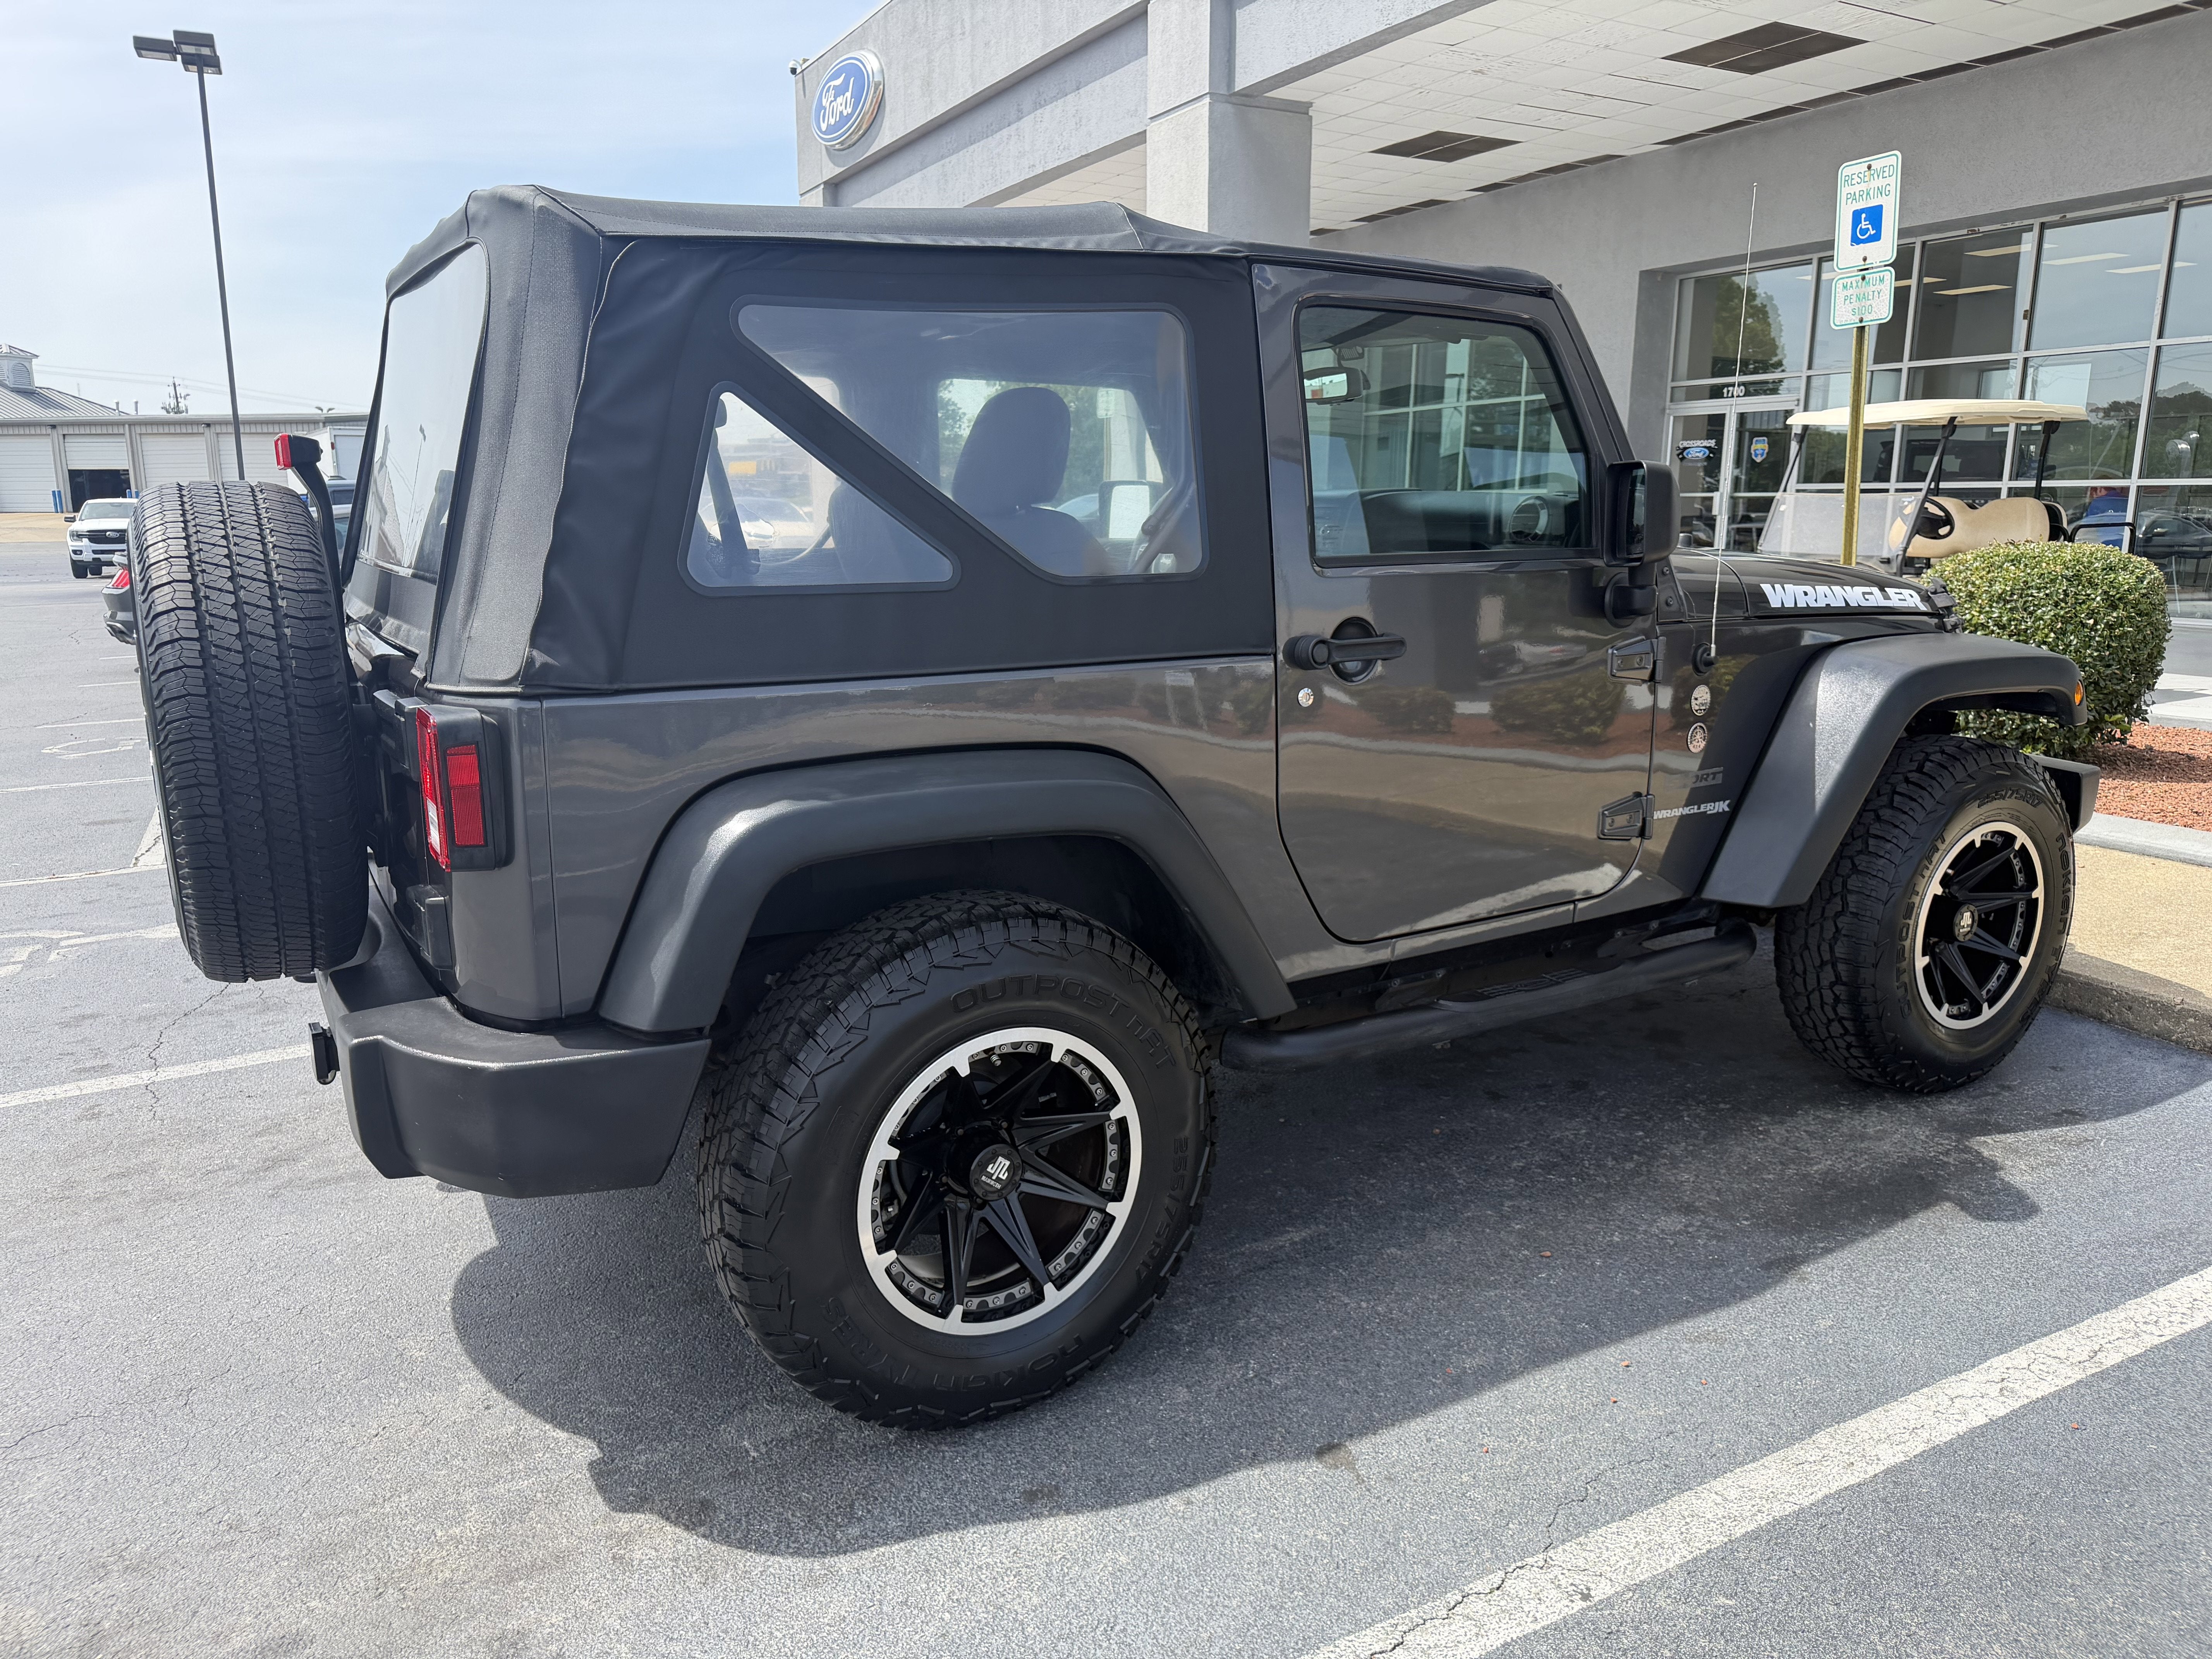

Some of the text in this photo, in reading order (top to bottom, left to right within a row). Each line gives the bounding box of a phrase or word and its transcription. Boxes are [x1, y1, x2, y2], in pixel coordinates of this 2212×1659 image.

[820, 73, 854, 131] Ford
[1843, 164, 1894, 188] RESERVED
[1845, 183, 1891, 205] PARKING
[1842, 274, 1885, 292] MAXIMUM
[1844, 289, 1882, 305] PENALTY
[1723, 386, 1745, 397] 1700
[1759, 583, 1928, 611] WRANGLER
[1896, 883, 1920, 1020] OUTPOST
[950, 973, 1130, 1017] OUTPOST
